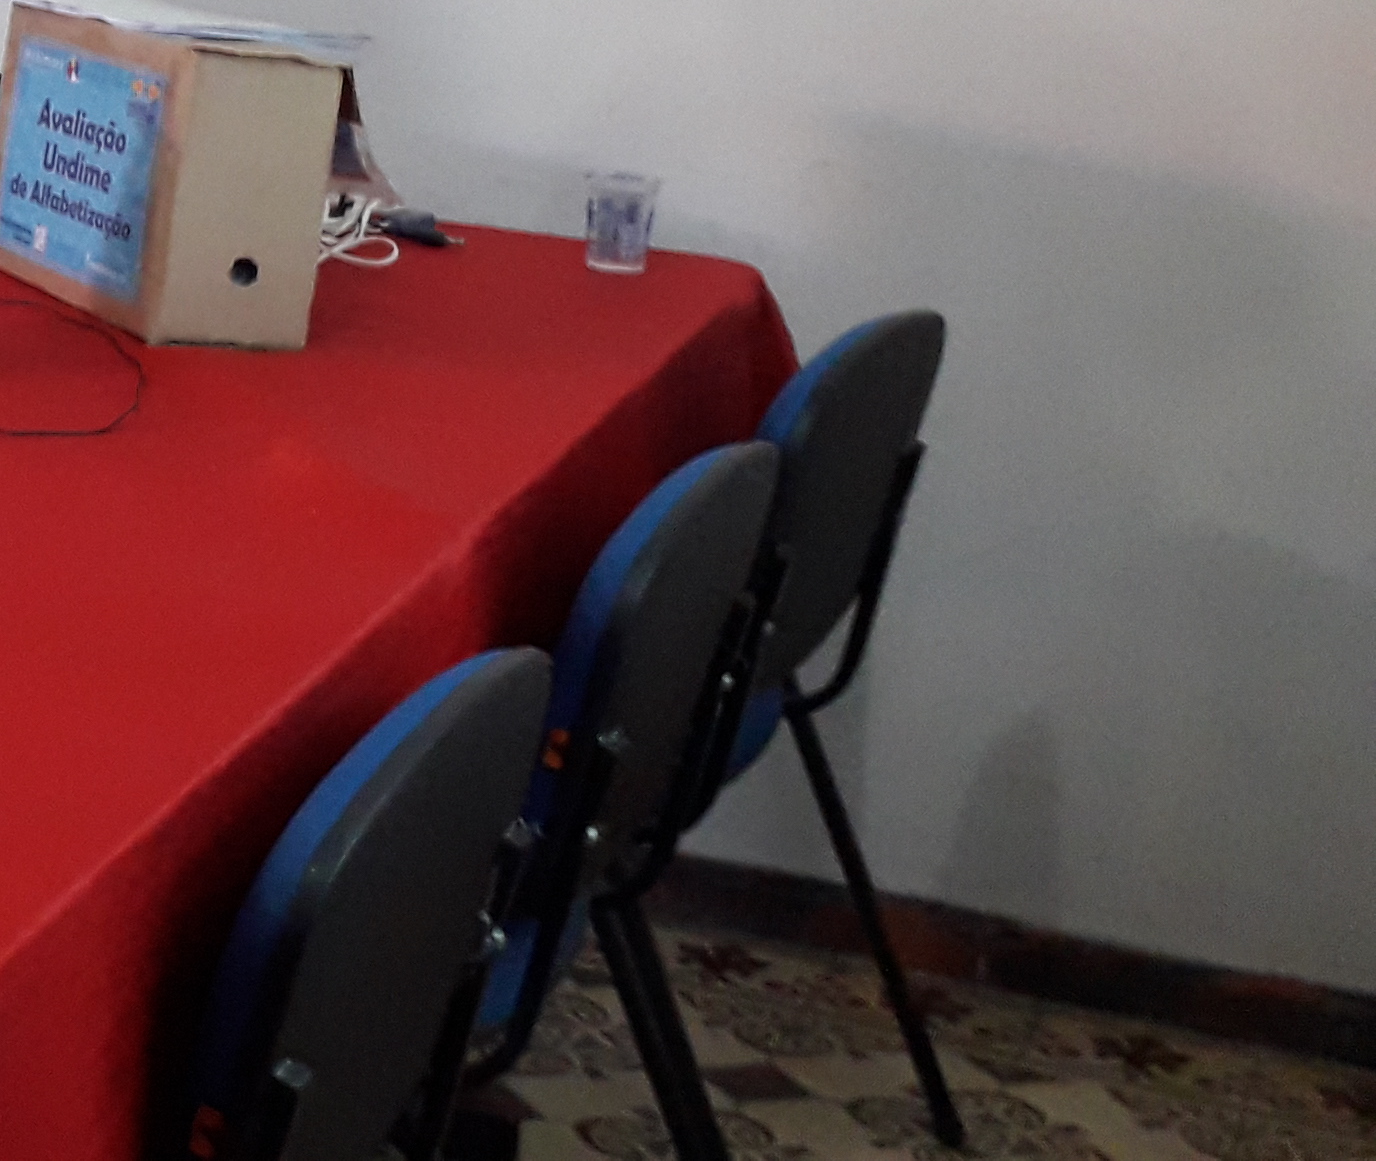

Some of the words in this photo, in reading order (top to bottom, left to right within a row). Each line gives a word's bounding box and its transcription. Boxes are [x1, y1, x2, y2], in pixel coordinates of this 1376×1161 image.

[37, 97, 127, 156] Avaliação
[43, 140, 112, 194] Undime
[10, 172, 27, 199] de
[29, 179, 131, 241] Alfabetização
